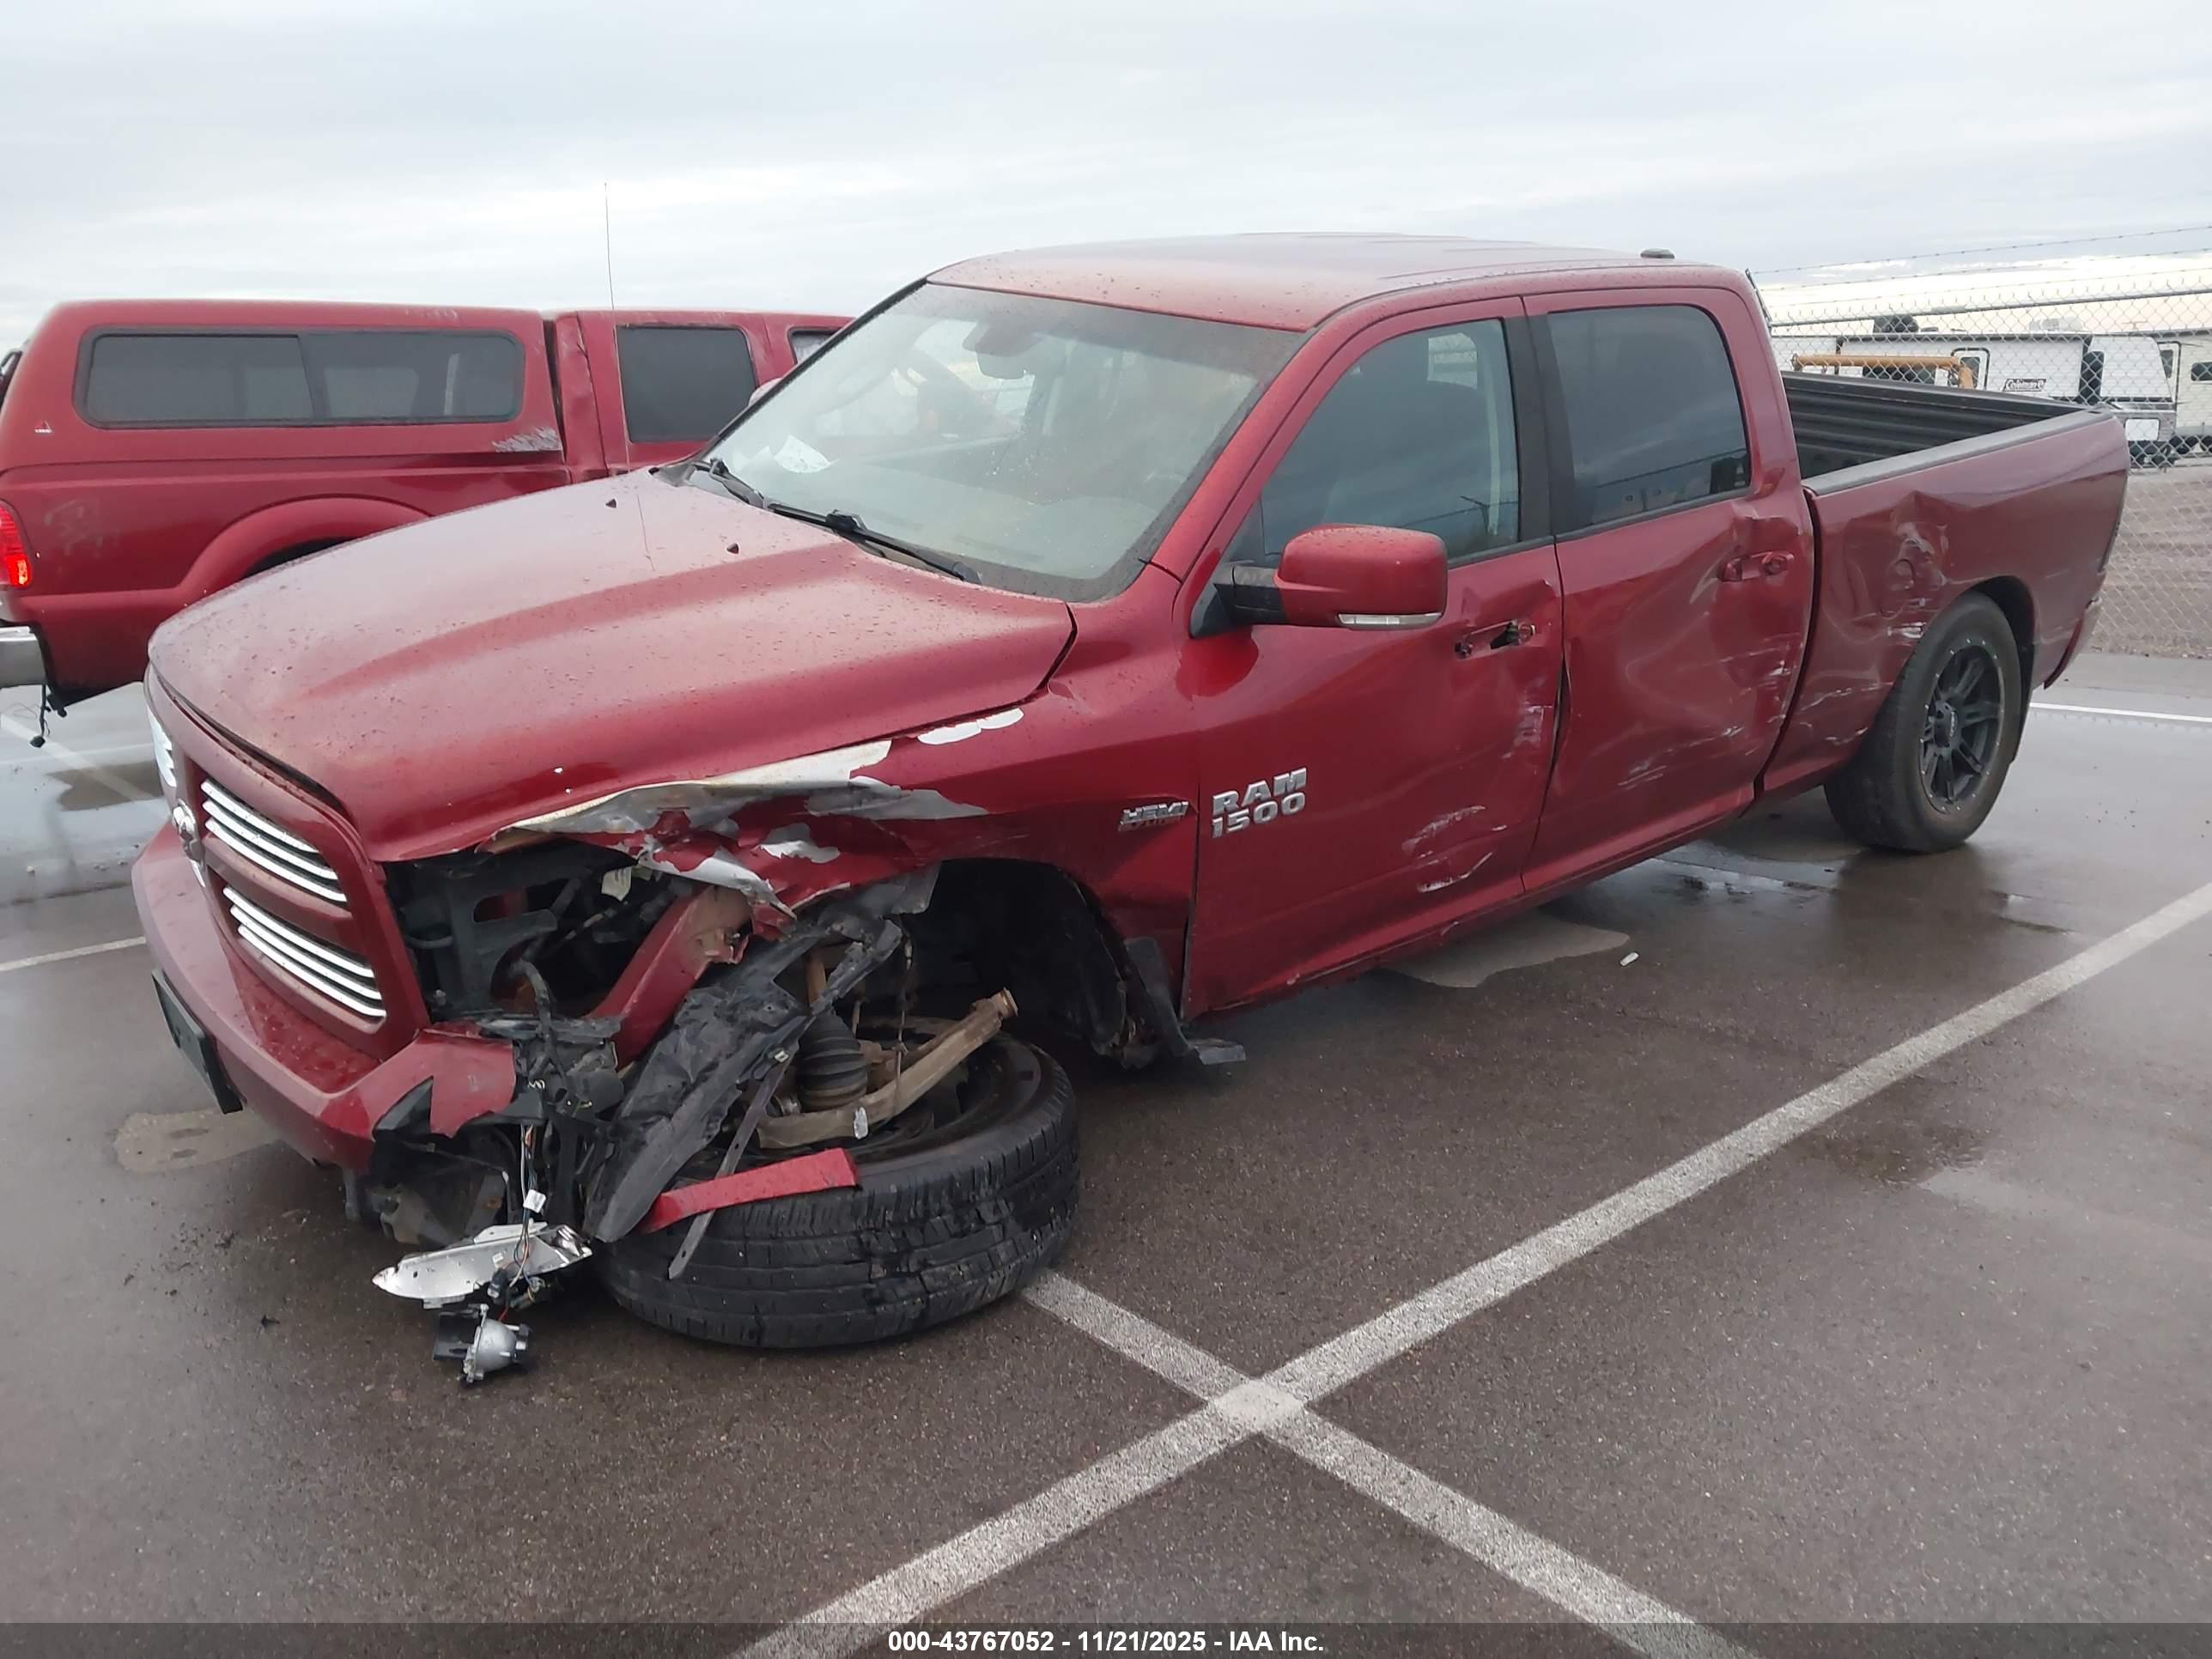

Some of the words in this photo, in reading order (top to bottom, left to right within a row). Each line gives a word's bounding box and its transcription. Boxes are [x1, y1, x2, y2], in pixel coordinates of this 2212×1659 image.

[1120, 800, 1188, 825] HEMI
[1212, 767, 1307, 816] RAM
[1212, 792, 1306, 839] 1500
